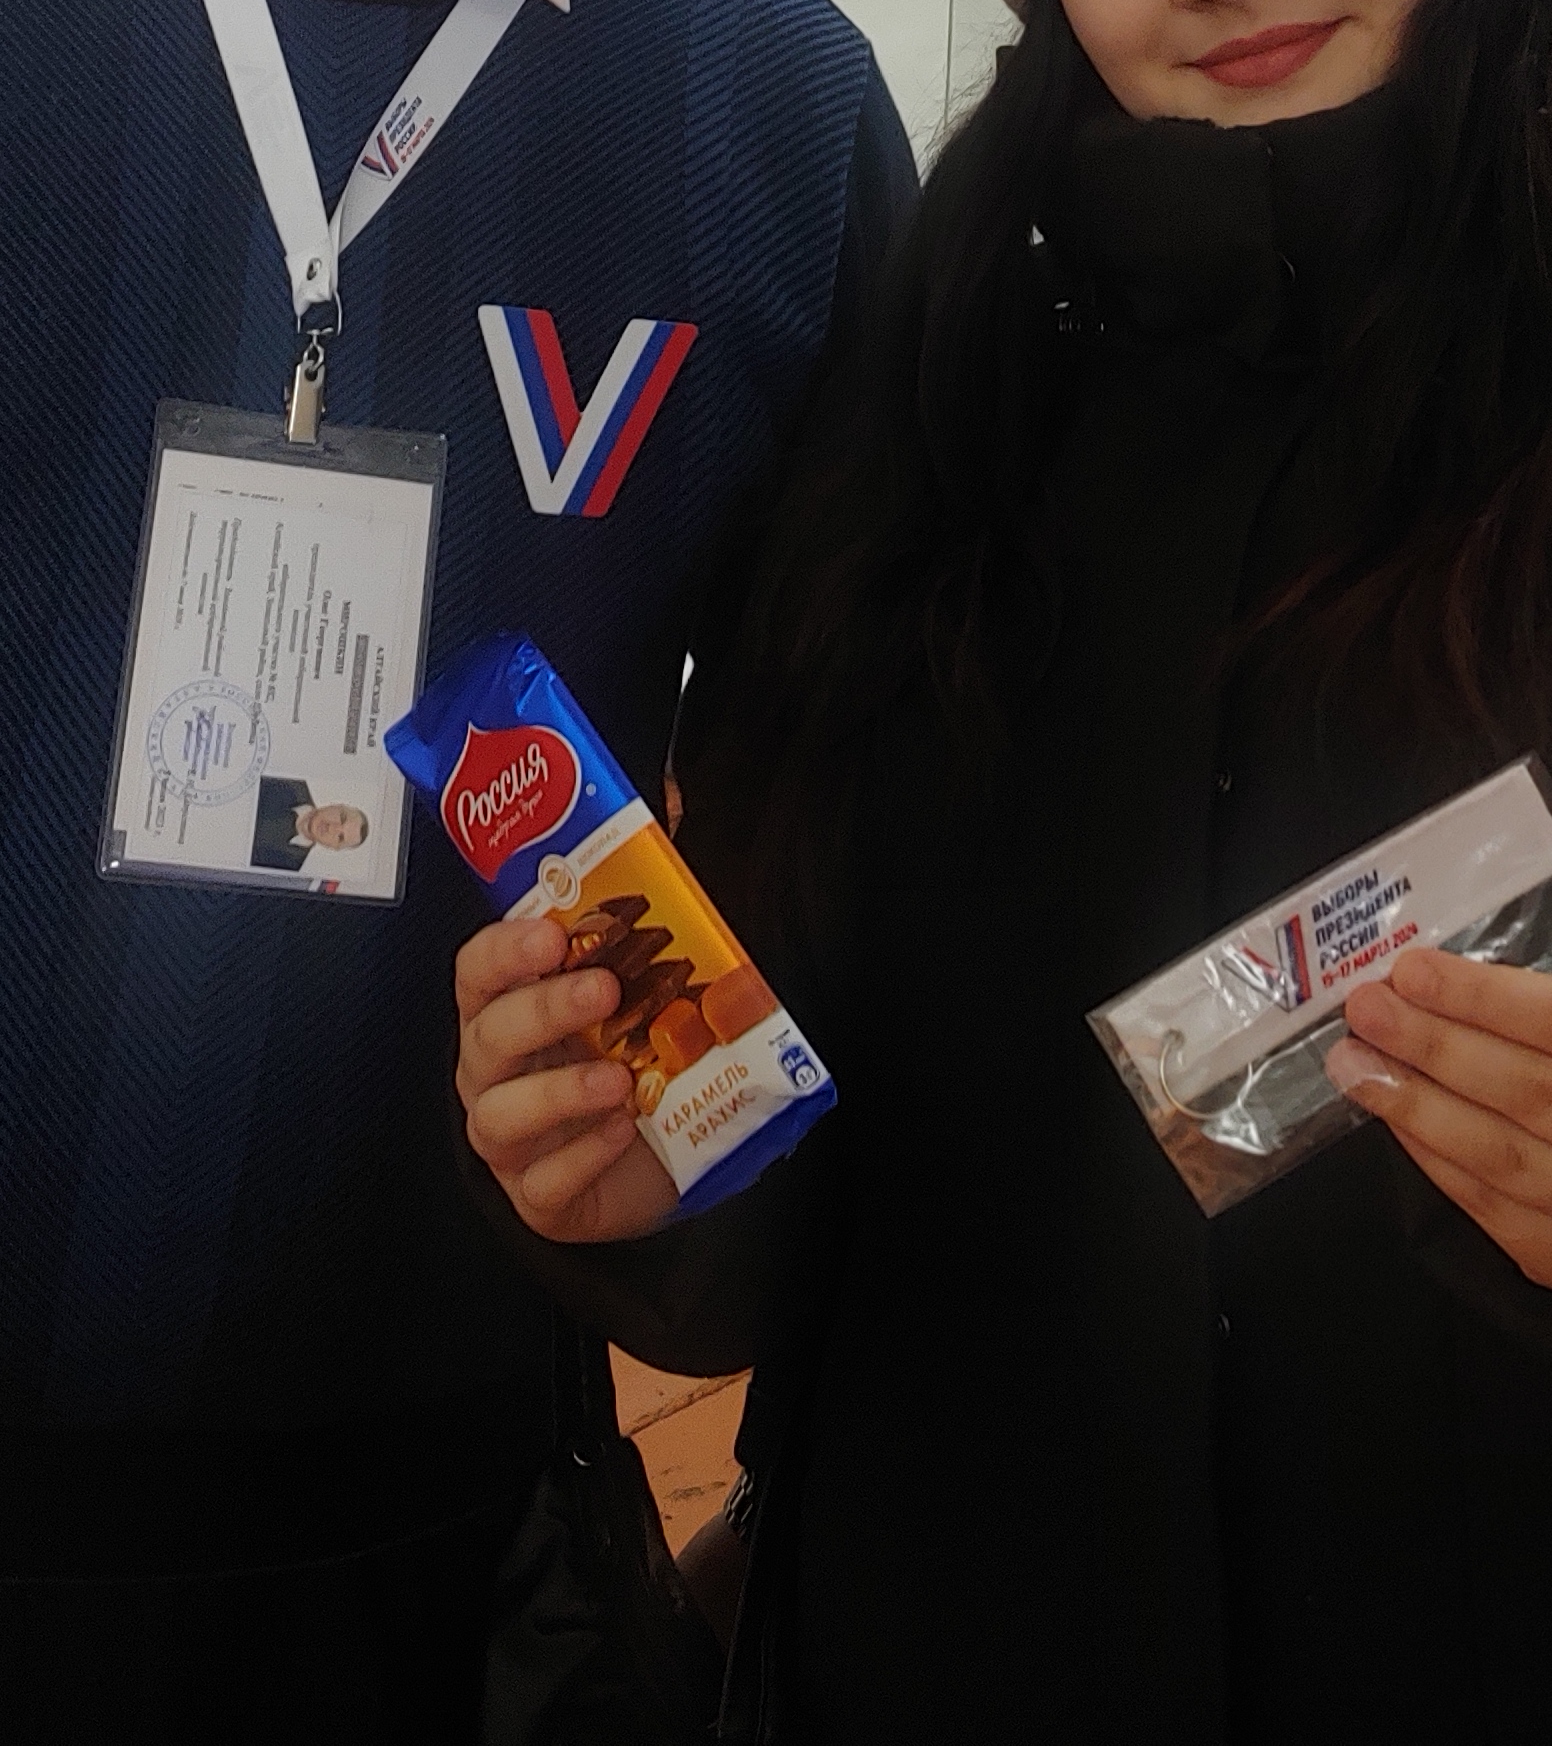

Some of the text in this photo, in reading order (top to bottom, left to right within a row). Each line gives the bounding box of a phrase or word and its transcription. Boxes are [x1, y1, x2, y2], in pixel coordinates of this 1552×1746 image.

[1311, 869, 1379, 923] ВЫБОРЫ
[1315, 875, 1412, 947] ПРЕЗИДЕНТА
[1319, 921, 1380, 970] РОССИИ
[662, 1062, 748, 1137] КАРАМЕЛЬ
[687, 1088, 756, 1149] АРАХИС
